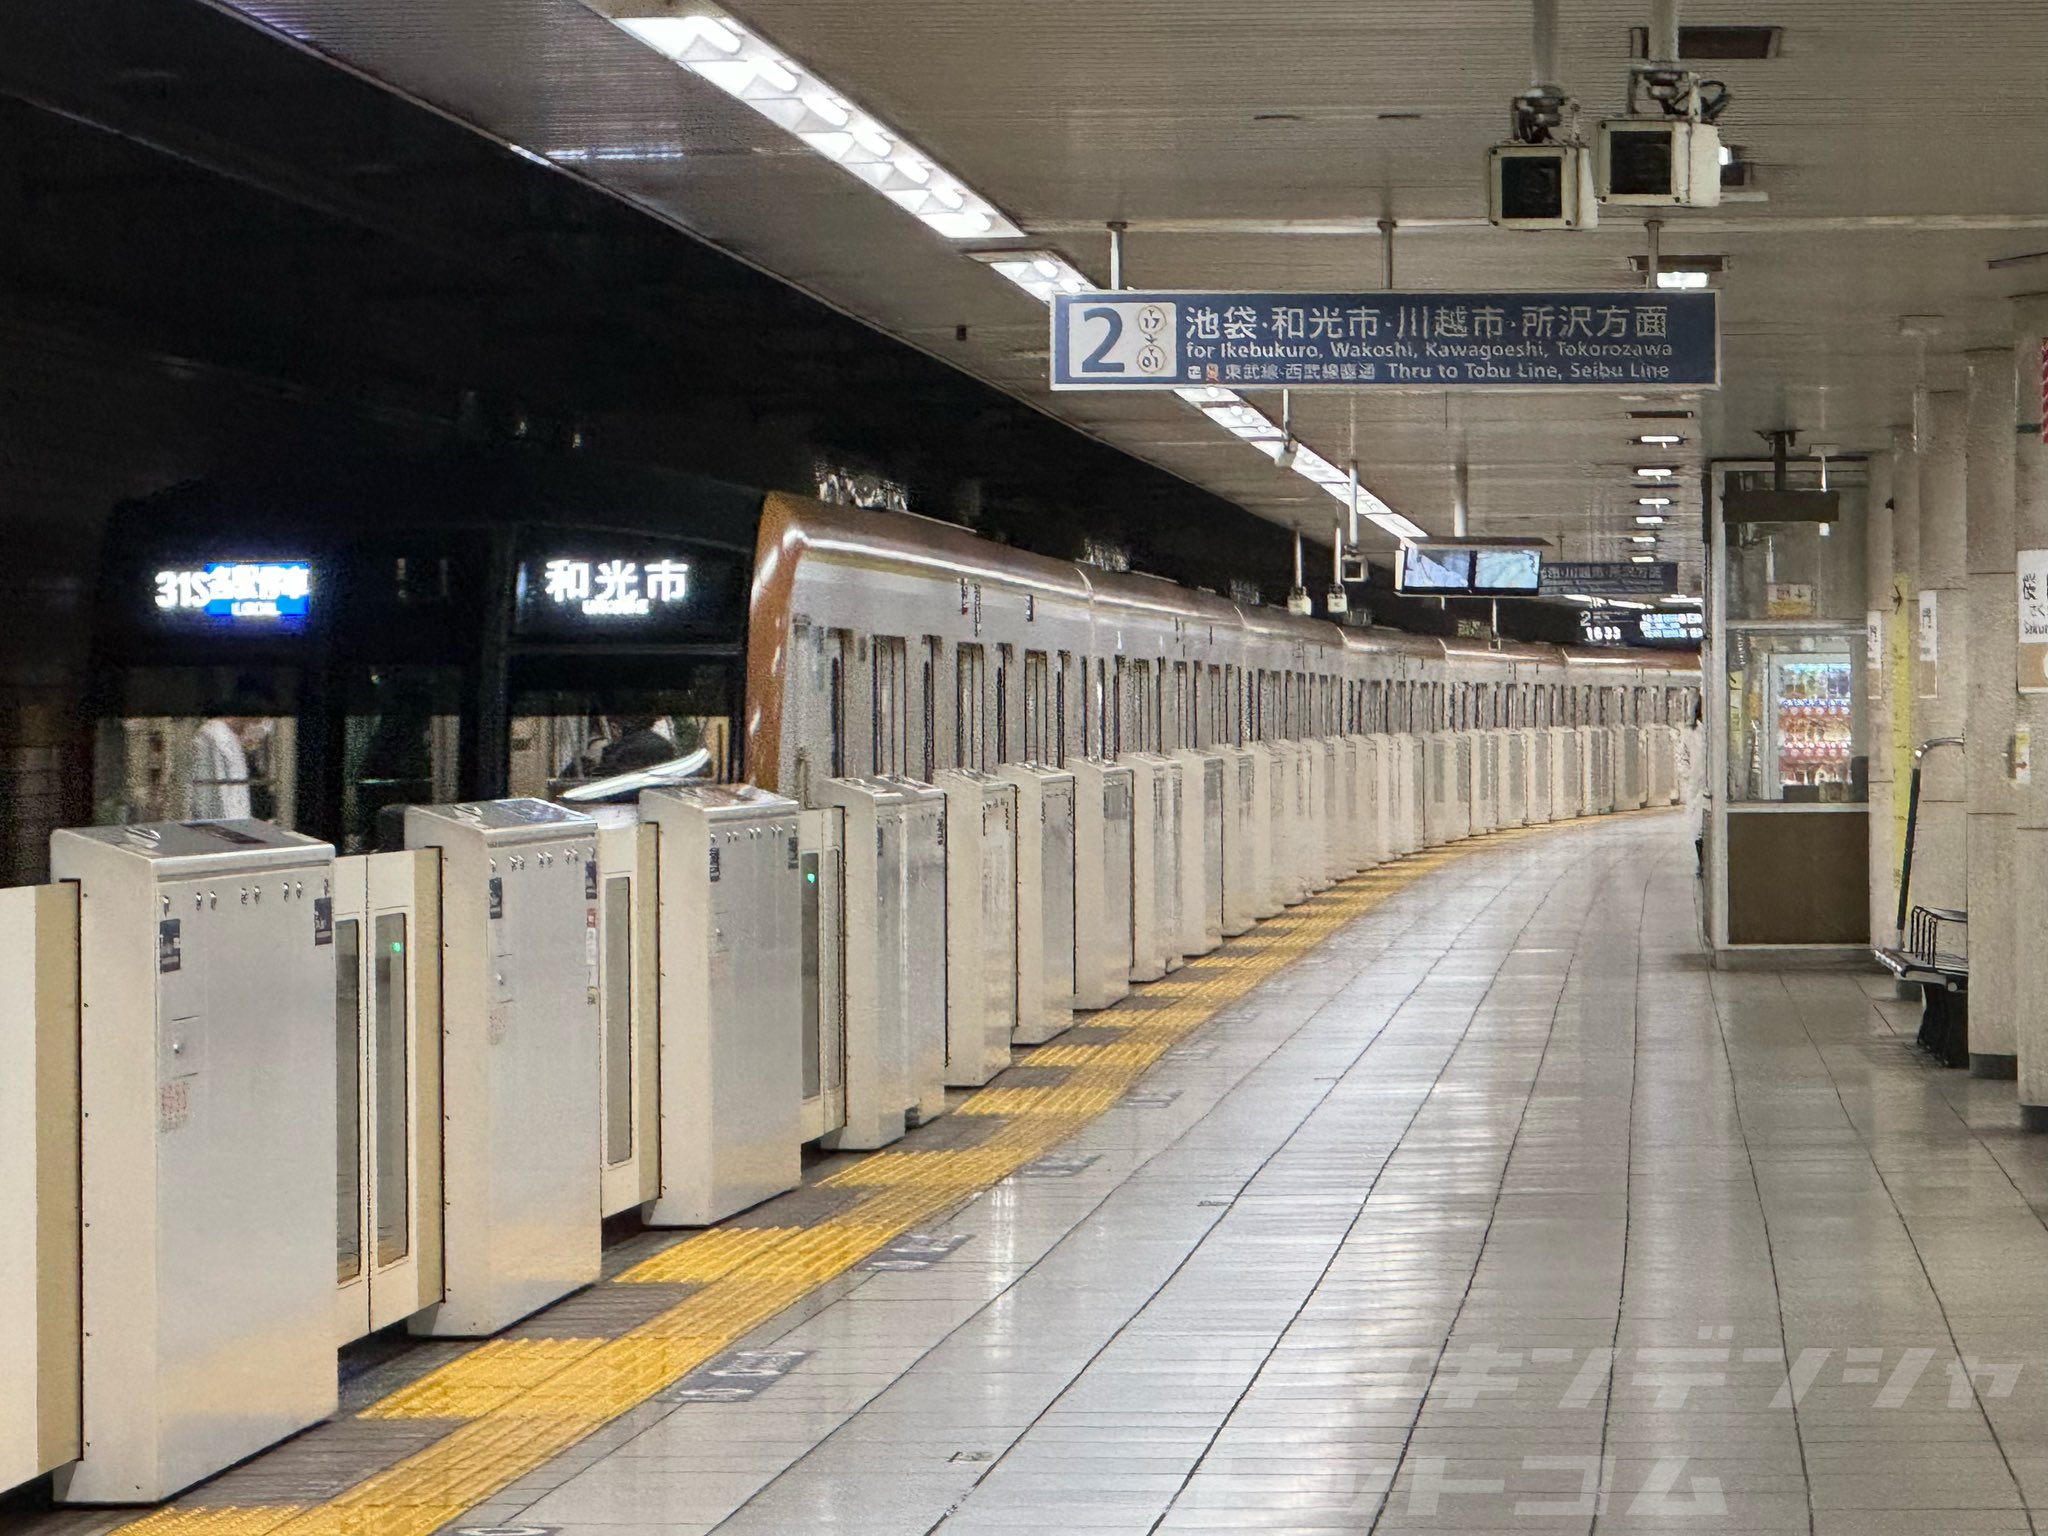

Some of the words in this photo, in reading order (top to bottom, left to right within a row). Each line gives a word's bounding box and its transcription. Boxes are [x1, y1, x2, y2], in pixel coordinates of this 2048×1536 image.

[1081, 307, 1125, 373] 2
[1186, 342, 1213, 358] for
[1220, 342, 1324, 360] Ikebukuro,
[1330, 342, 1418, 360] Wakoshi,
[1425, 342, 1550, 361] Kawagoeshi,
[1556, 342, 1673, 358] Tokorozawa
[1387, 362, 1432, 379] Thru
[1438, 364, 1459, 379] to
[1463, 362, 1511, 379] Tobu
[1517, 362, 1563, 381] Line,
[1569, 362, 1624, 379] Seibu
[1630, 362, 1670, 379] Line
[545, 559, 689, 602] 和光市
